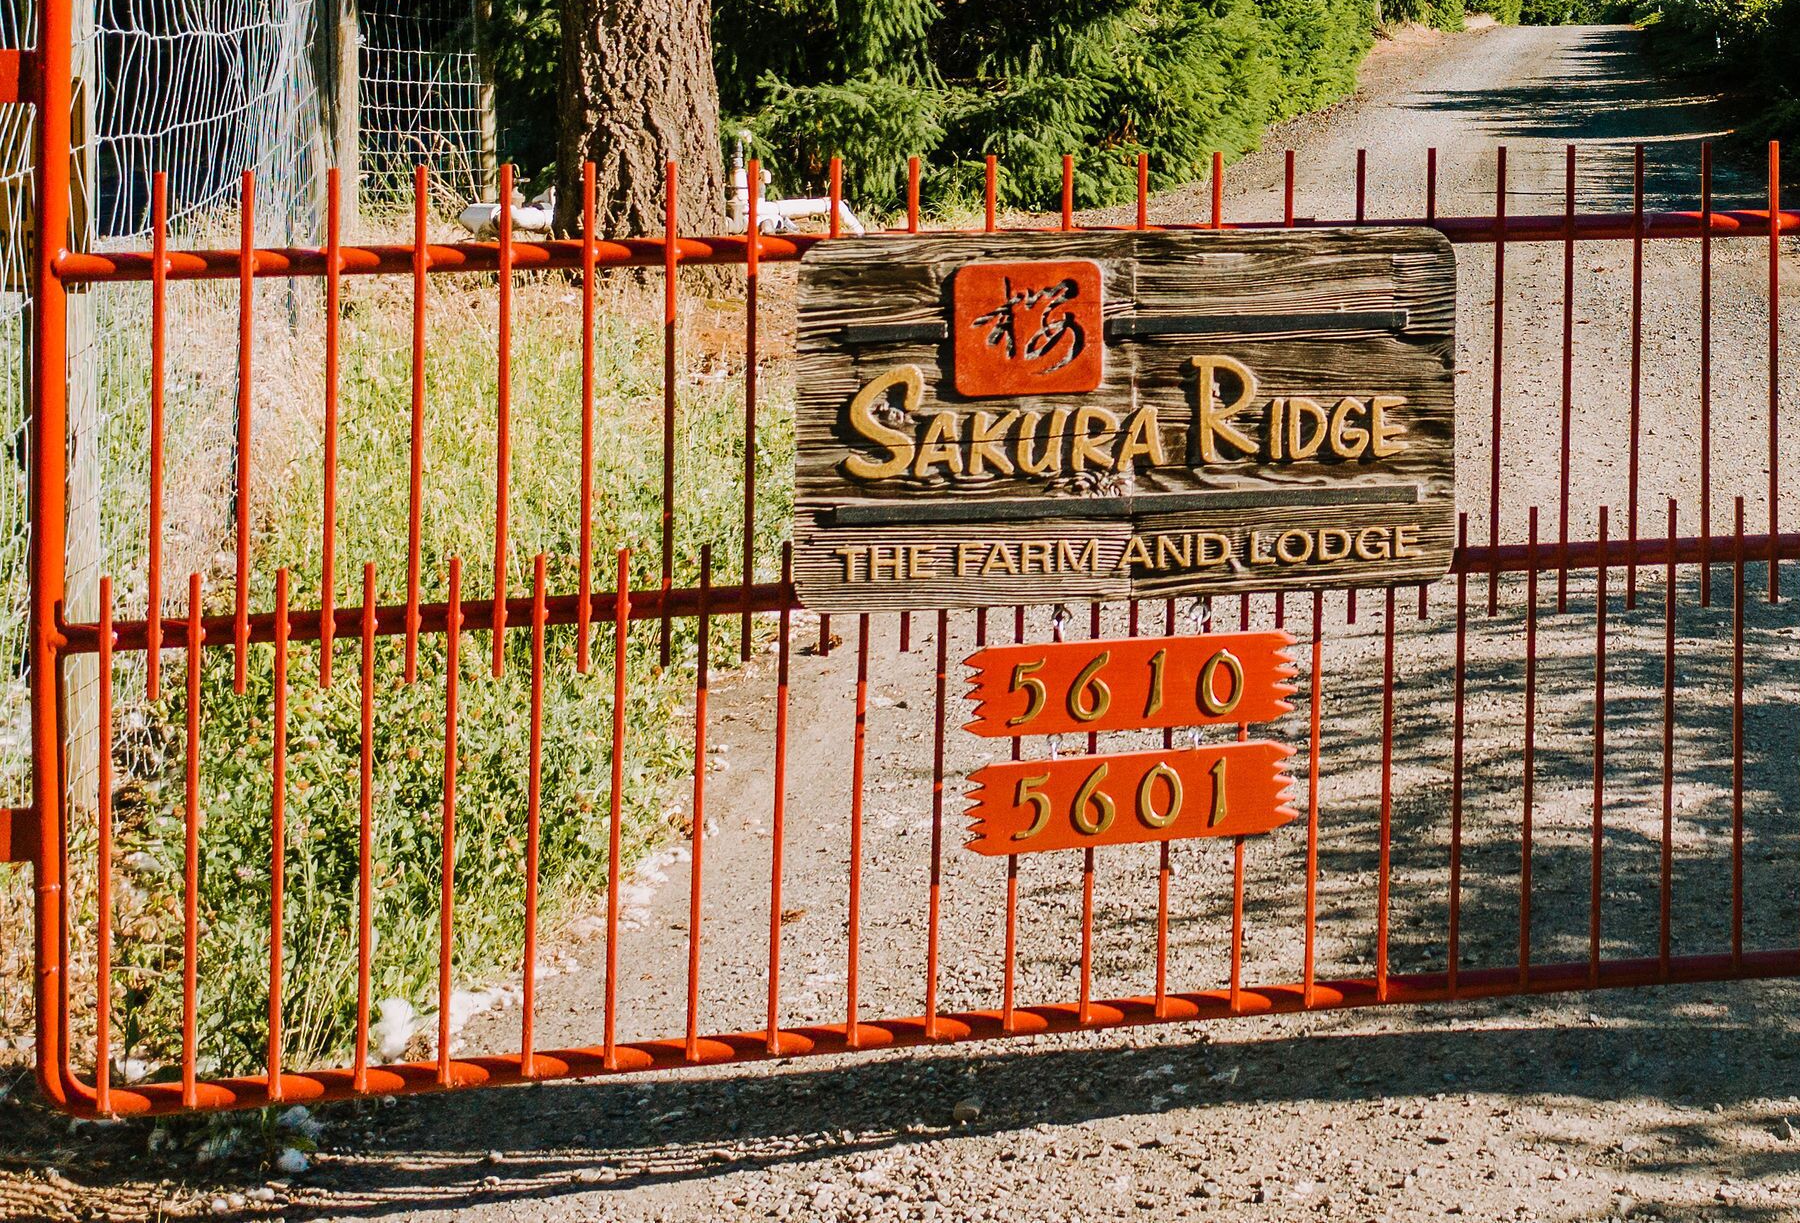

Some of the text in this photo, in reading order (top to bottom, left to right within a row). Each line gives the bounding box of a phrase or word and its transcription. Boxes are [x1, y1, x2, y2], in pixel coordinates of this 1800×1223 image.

[845, 354, 1409, 480] SAKURA RIDGE
[835, 525, 1422, 582] THE FARM AND LODGE
[1008, 647, 1245, 726] 5610
[1012, 756, 1229, 840] 5601
